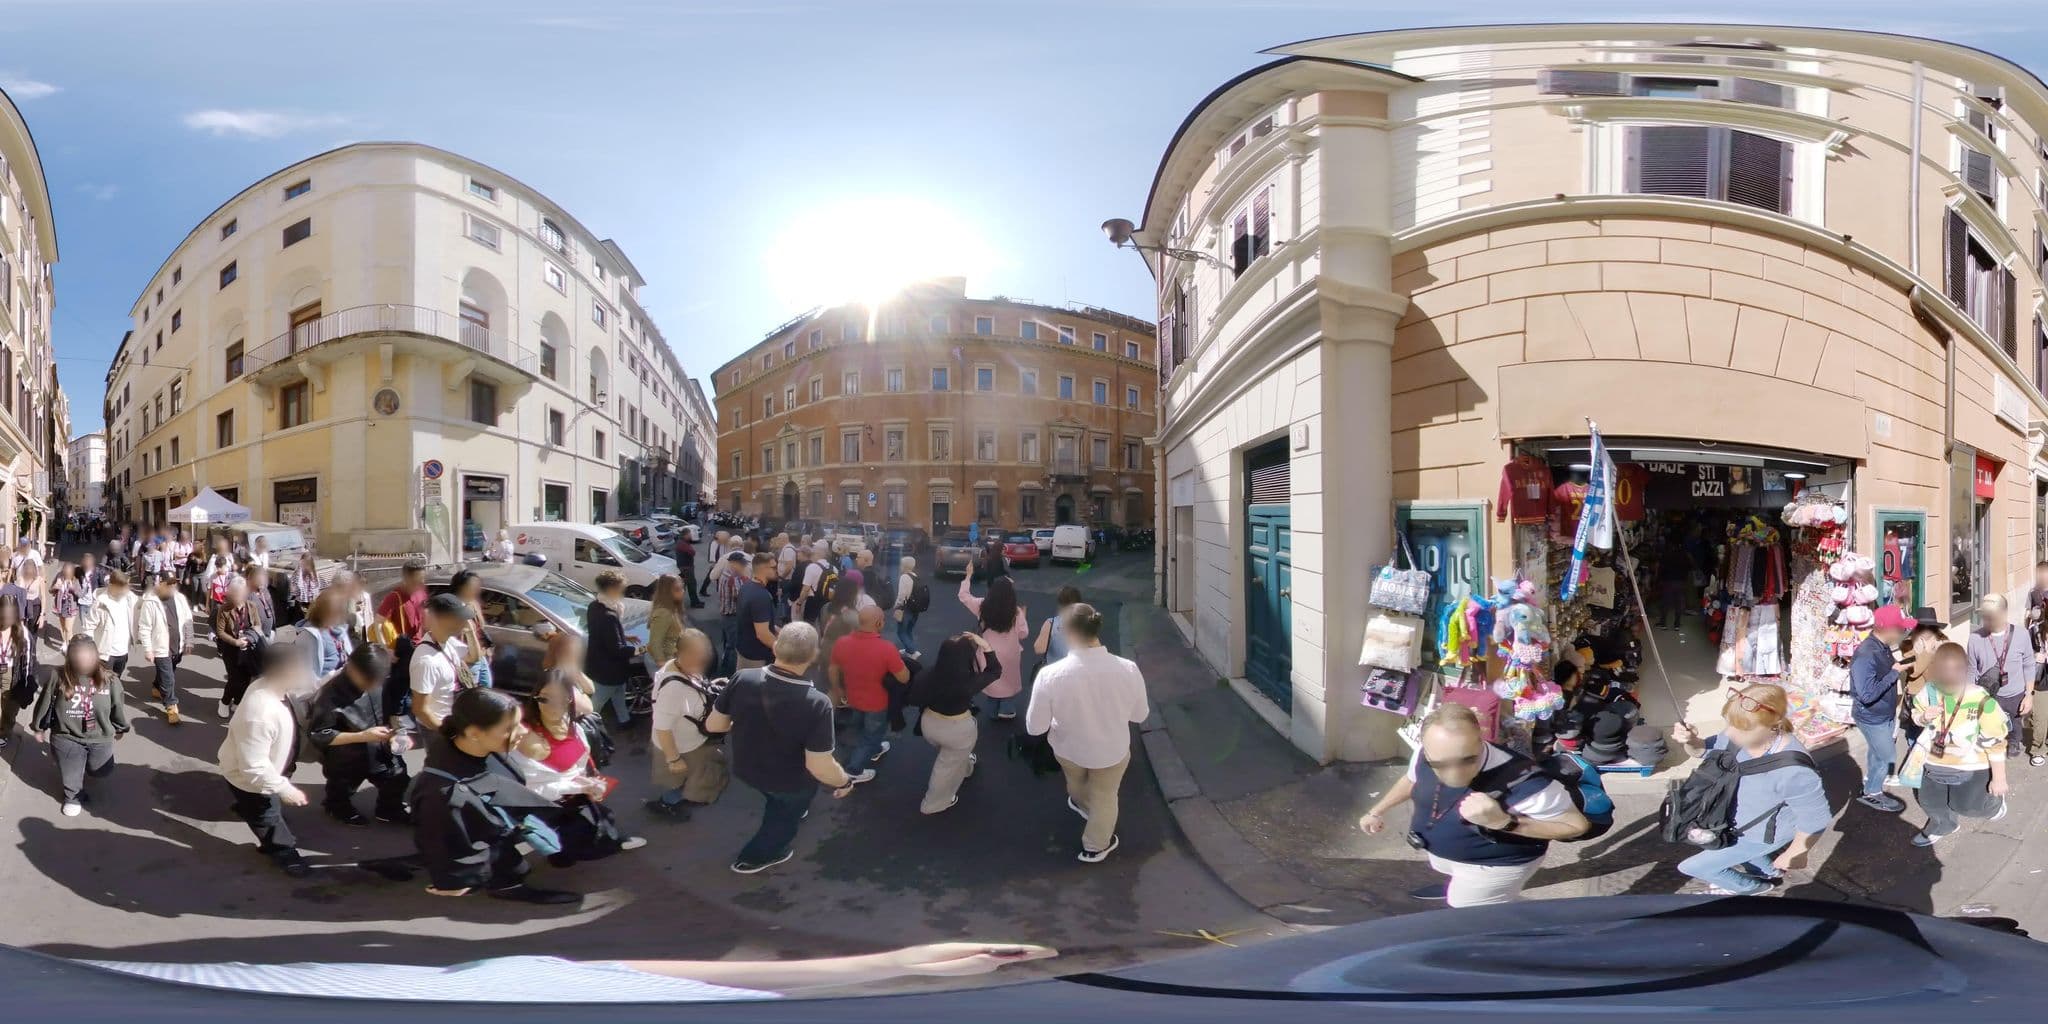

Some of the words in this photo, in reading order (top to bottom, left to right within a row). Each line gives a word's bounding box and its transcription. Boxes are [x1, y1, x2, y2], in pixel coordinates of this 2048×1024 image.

[1698, 464, 1715, 480] STI
[1691, 481, 1724, 497] CAZZI
[1380, 582, 1413, 597] ROMA
